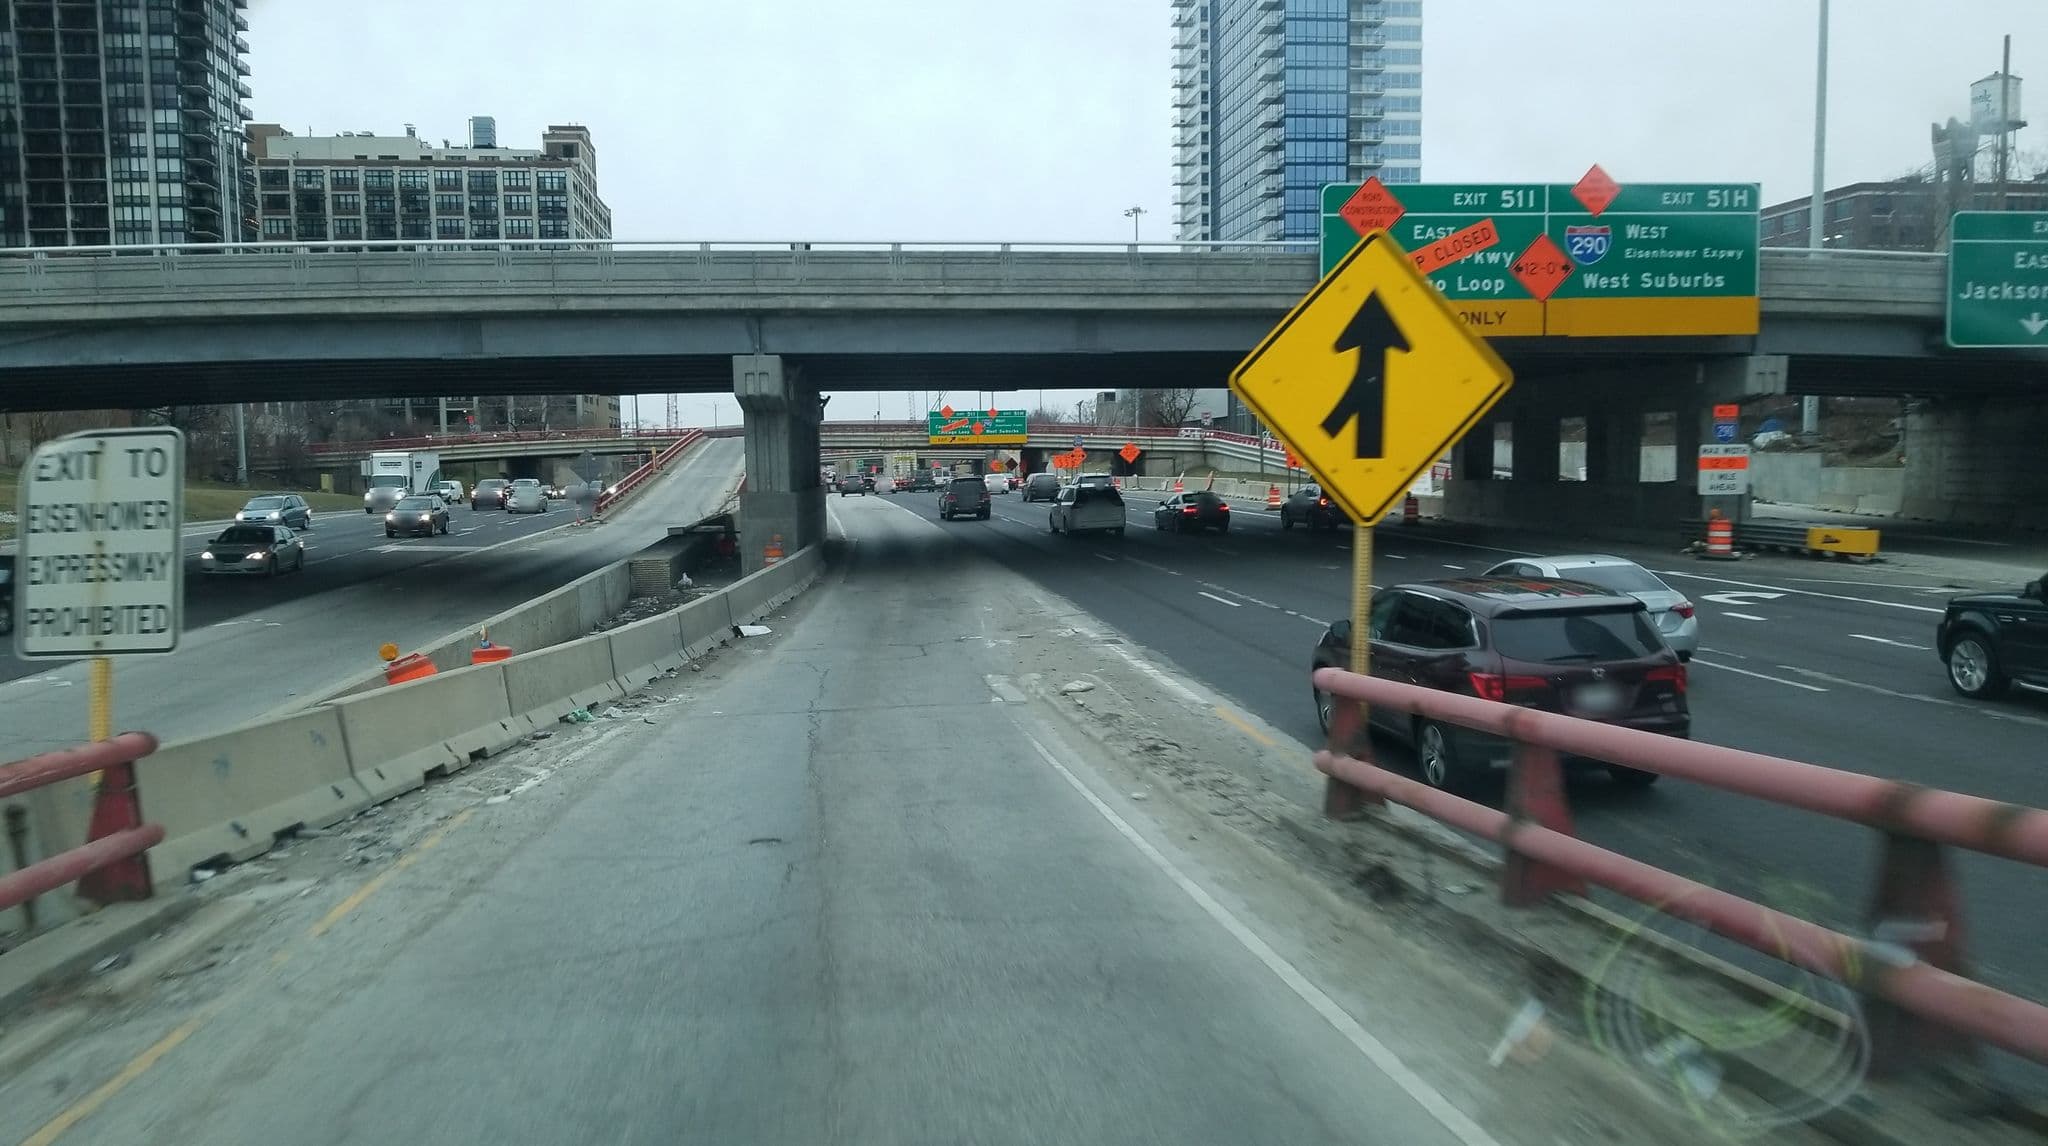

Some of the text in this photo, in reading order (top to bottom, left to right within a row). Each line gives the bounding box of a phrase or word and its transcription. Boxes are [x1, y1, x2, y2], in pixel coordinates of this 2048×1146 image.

[1453, 192, 1488, 206] EXIT
[1661, 189, 1749, 208] EXIT 51H
[1413, 224, 1456, 240] EAST
[1625, 224, 1669, 239] WEST
[1433, 227, 1492, 262] CLOSED
[1572, 235, 1608, 255] 290
[1623, 247, 1744, 260] Eisenhower Expwy
[1457, 275, 1506, 295] Loop
[1583, 271, 1726, 289] West Suburbs
[1458, 311, 1507, 325] ONLY
[35, 447, 169, 482] EXIT TO
[26, 500, 171, 534] EISENHOWER
[26, 552, 173, 586] EXPRESSWAY
[25, 604, 169, 638] PROHIBITED
